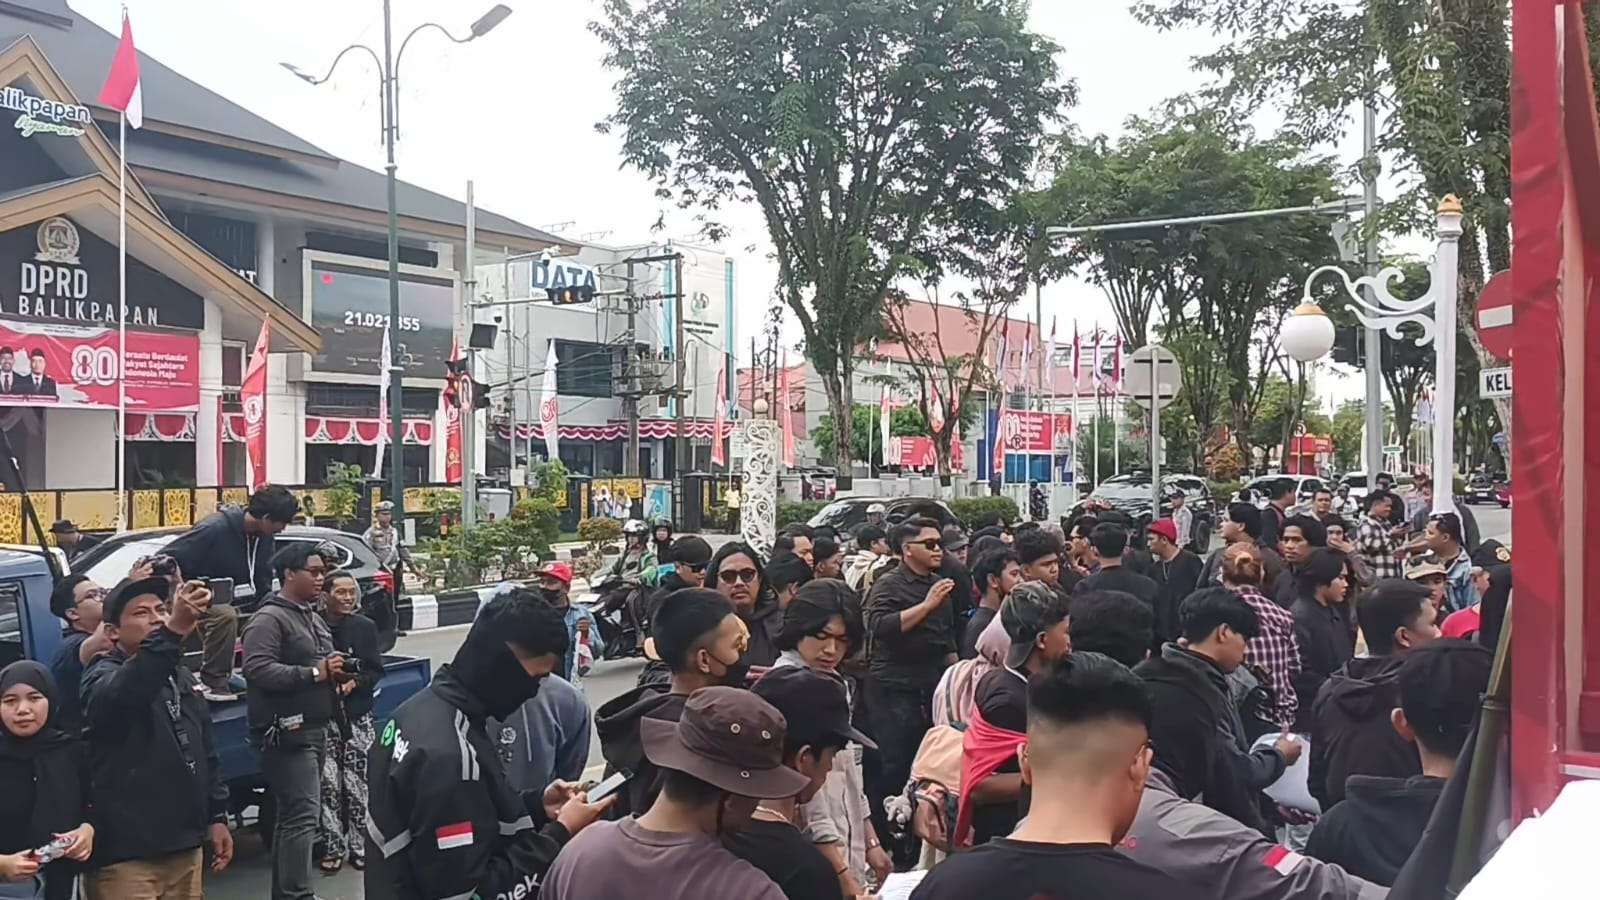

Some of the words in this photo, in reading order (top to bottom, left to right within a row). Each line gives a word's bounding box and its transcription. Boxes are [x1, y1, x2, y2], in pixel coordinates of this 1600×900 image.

[21, 263, 88, 299] DPRD
[532, 260, 597, 292] DATA
[71, 345, 118, 386] 80
[125, 352, 151, 361] ersatu
[125, 361, 147, 370] akyat
[124, 370, 157, 378] ndonesia
[1486, 373, 1512, 392] KEL
